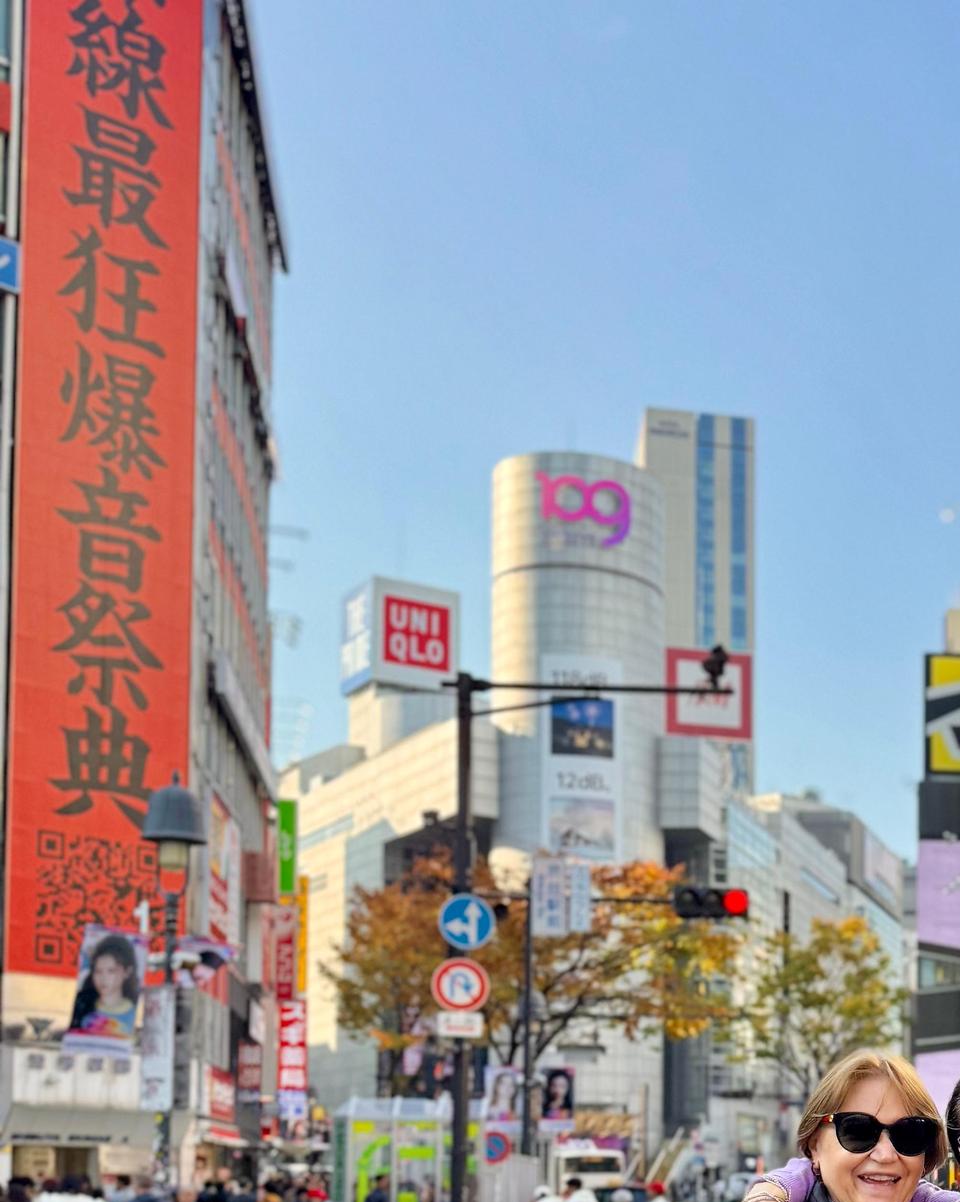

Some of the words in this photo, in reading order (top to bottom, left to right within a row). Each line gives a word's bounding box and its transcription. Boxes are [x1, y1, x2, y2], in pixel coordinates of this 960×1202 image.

[50, 0, 175, 830] 線最狂爆音祭典
[535, 471, 631, 548] 109
